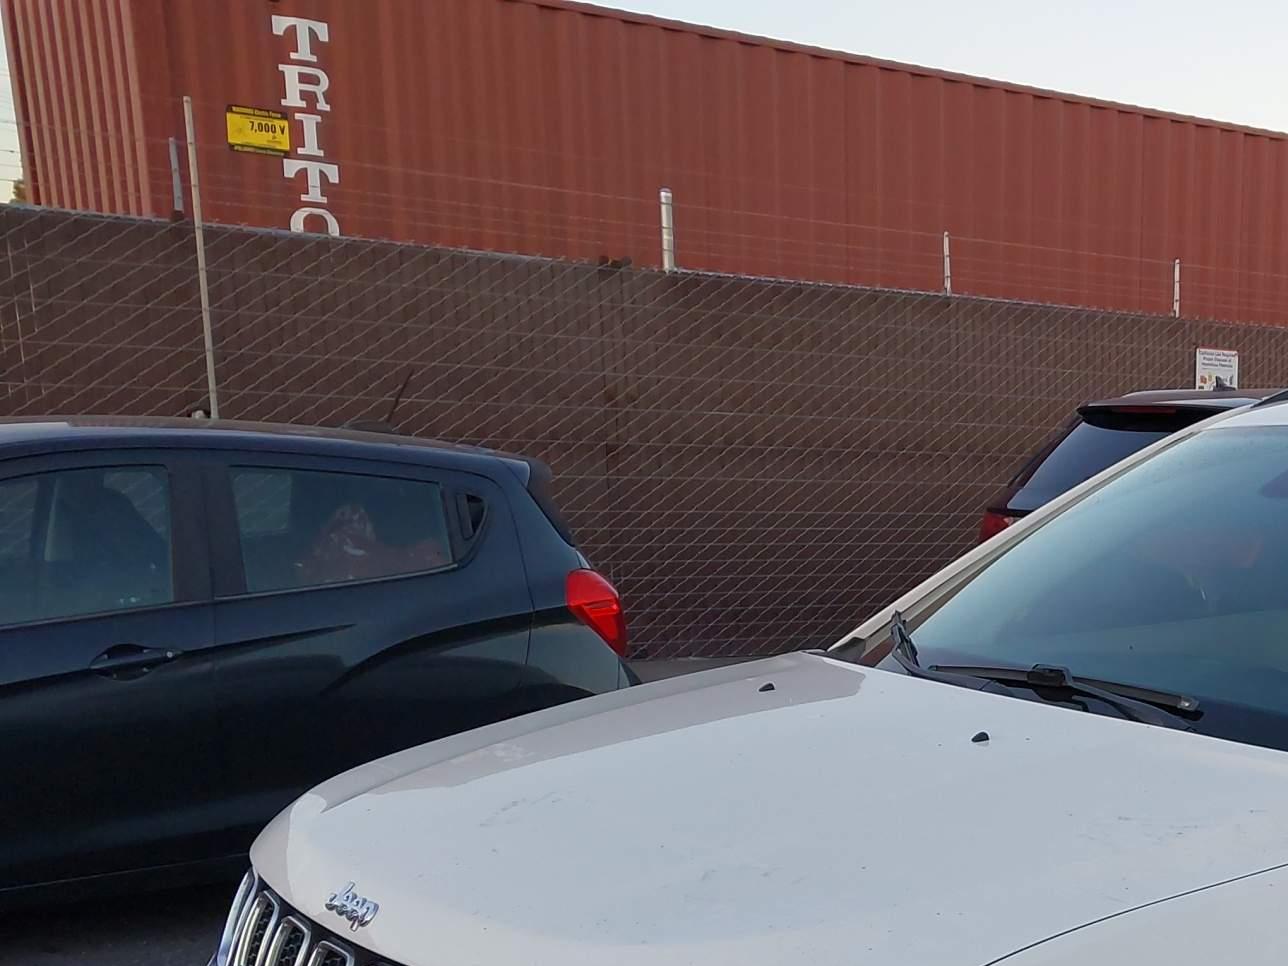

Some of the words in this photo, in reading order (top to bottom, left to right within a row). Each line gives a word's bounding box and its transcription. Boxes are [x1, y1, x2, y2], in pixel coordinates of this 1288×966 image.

[249, 121, 277, 134] 7,000
[279, 124, 286, 136] V
[325, 881, 379, 931] Jeep
